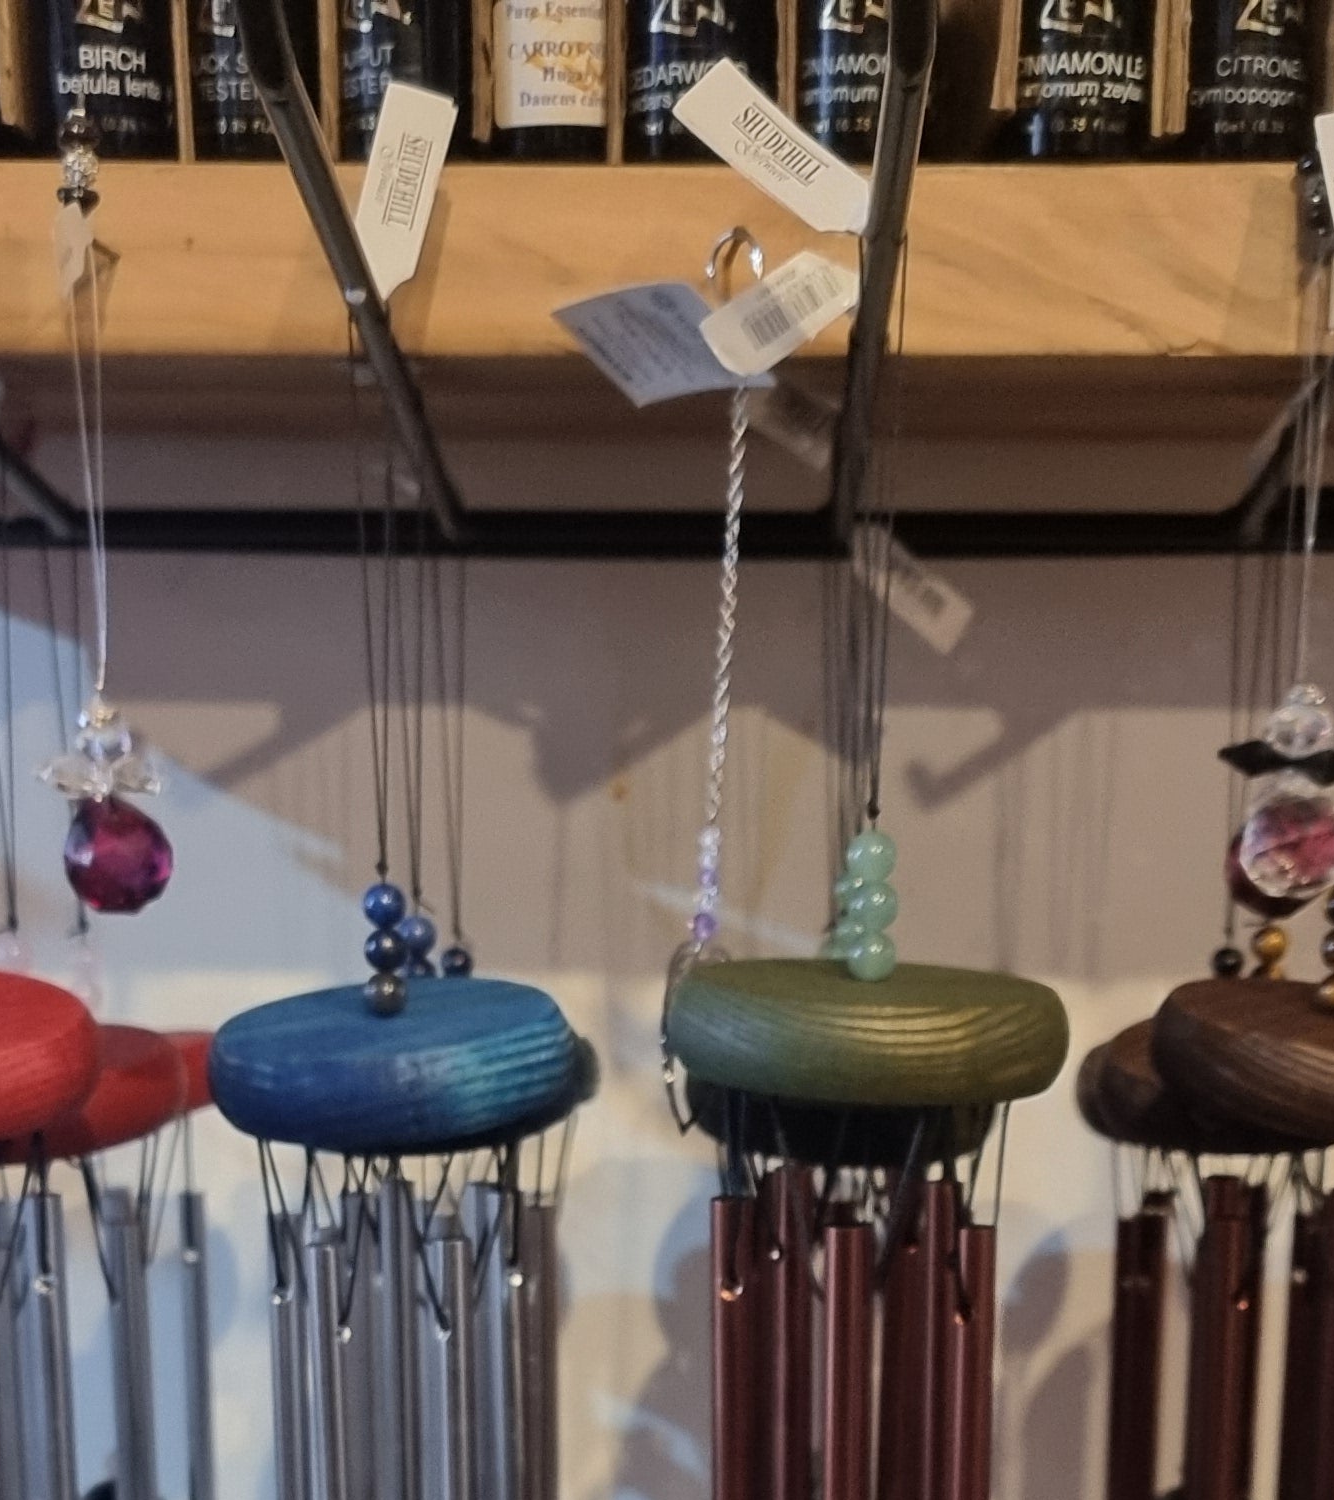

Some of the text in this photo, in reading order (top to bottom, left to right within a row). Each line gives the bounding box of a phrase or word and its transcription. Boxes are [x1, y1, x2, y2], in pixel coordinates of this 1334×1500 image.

[78, 44, 147, 73] BIRCH
[58, 71, 120, 96] betula
[734, 105, 824, 185] SHUDEHILL
